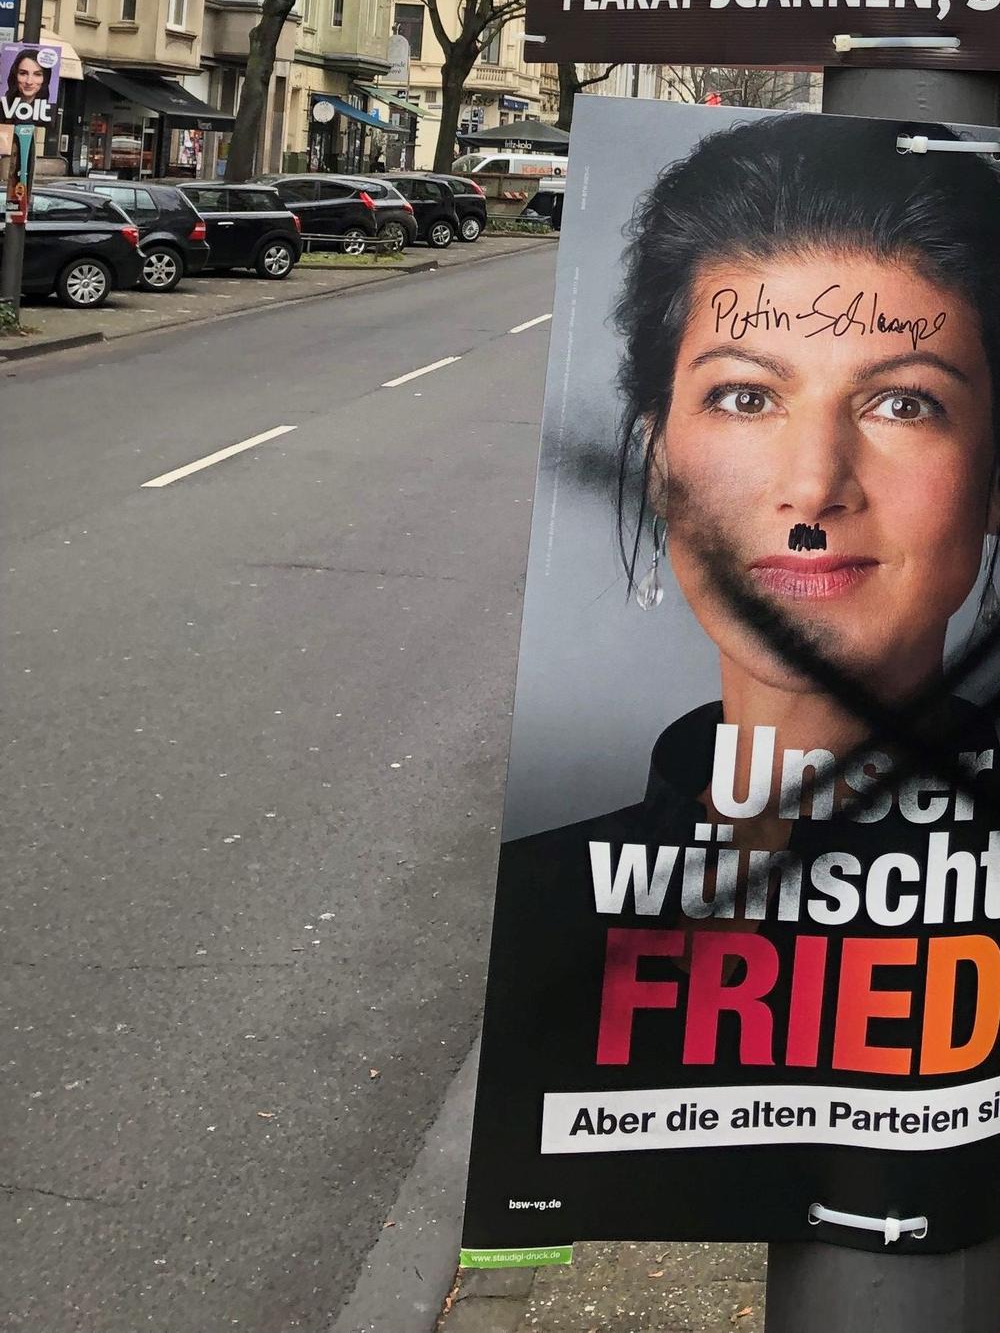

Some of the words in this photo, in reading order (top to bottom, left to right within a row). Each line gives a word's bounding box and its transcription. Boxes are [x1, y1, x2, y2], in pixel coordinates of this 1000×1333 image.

[1, 96, 52, 122] Volt
[711, 723, 994, 824] Unser
[569, 1107, 656, 1136] Aber
[666, 1103, 719, 1131] die
[730, 1100, 817, 1129] alten
[829, 1101, 969, 1134] Parteien
[508, 1199, 562, 1211] bsw-vg.de
